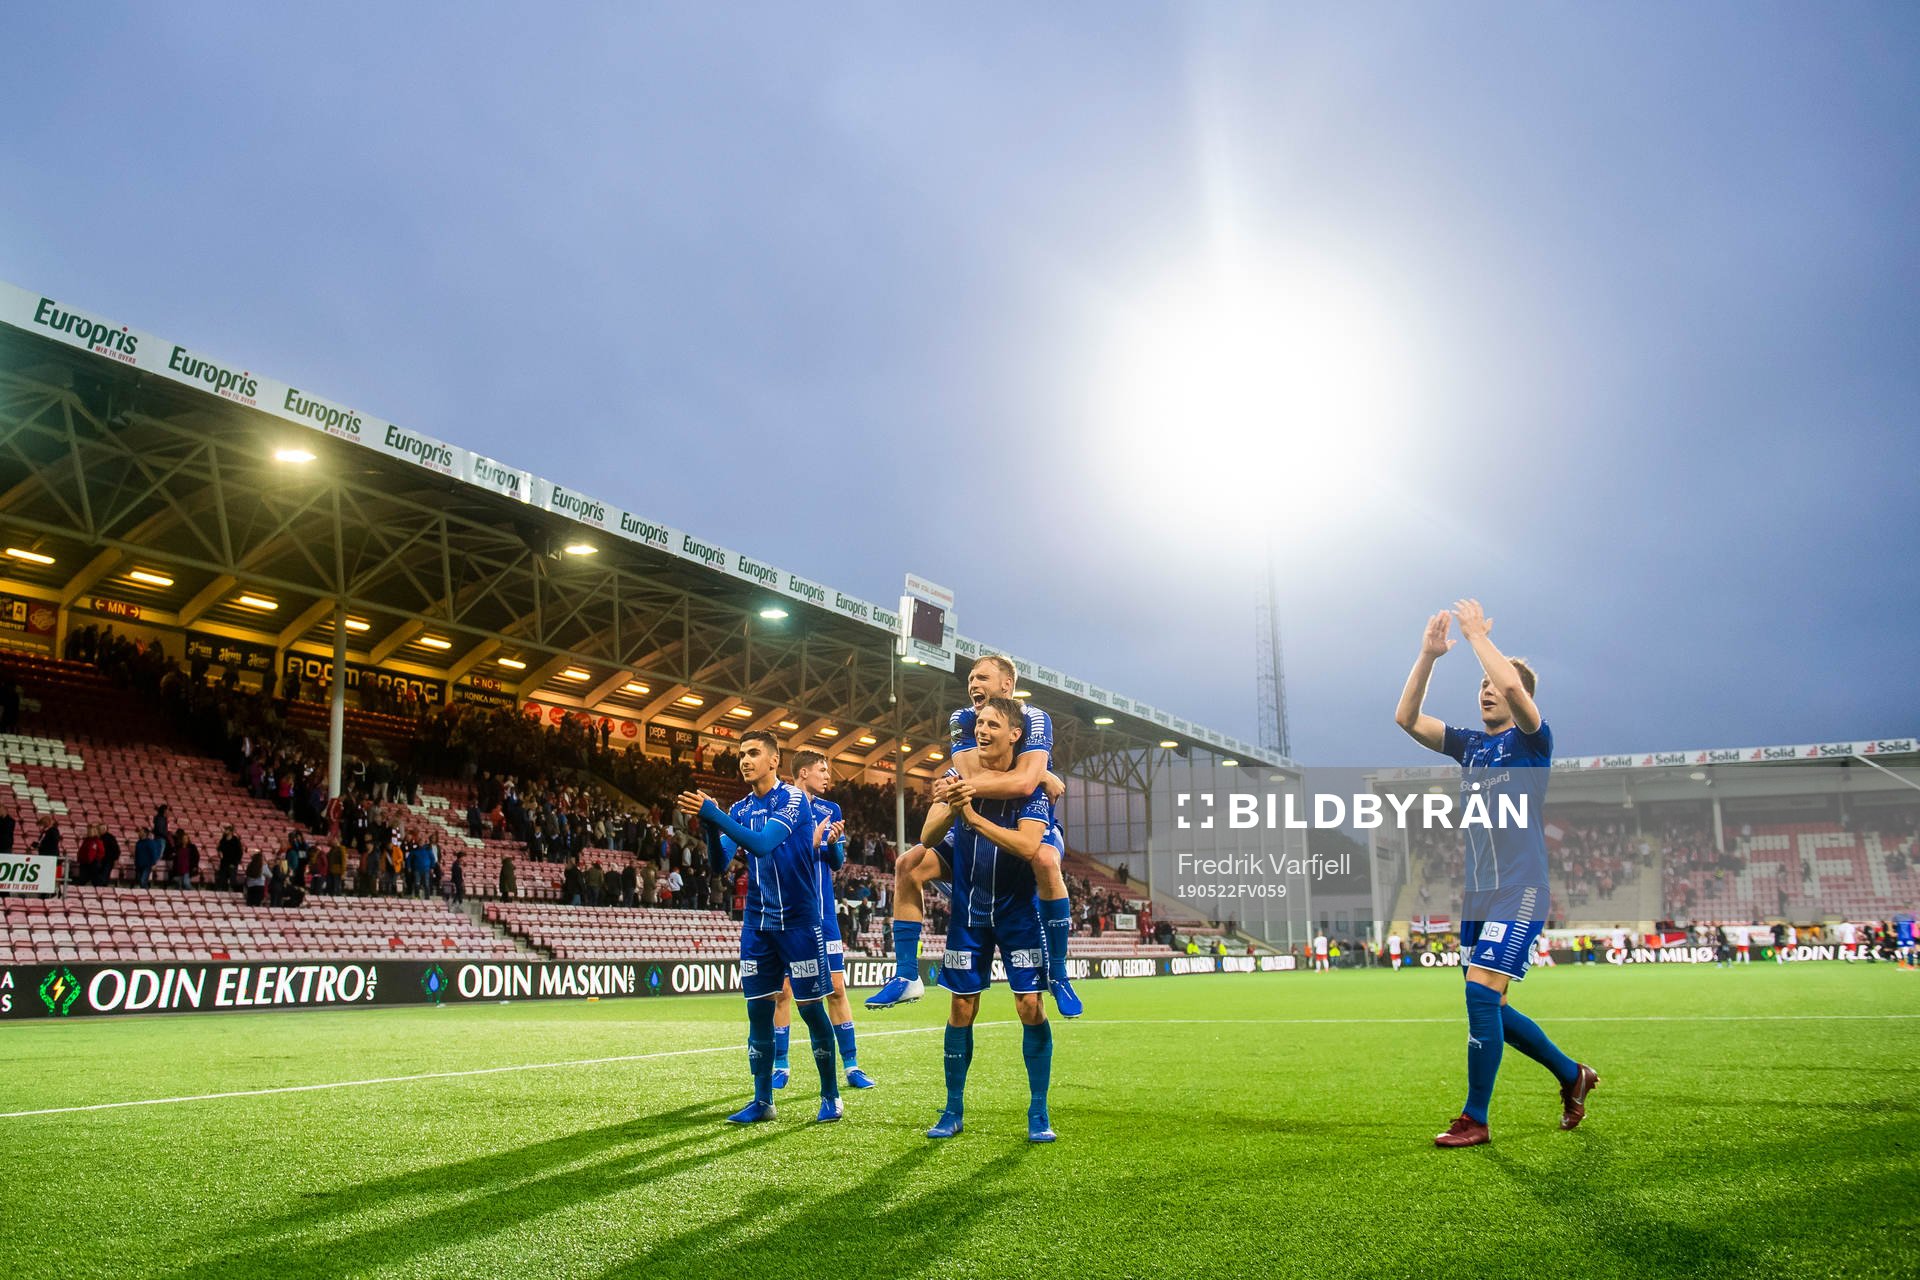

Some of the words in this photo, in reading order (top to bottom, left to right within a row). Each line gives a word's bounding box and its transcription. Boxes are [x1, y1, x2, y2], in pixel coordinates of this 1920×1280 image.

[34, 297, 138, 355] Europris
[168, 345, 258, 398] Europris
[284, 388, 362, 435] Europris
[384, 424, 453, 467] Europris
[552, 486, 605, 521] Europris
[621, 511, 669, 545] Europris
[683, 535, 726, 566] Europris
[738, 556, 778, 584] Europris
[789, 575, 825, 602] Europris
[107, 601, 127, 616] MN
[836, 592, 868, 618] Europris
[1655, 752, 1686, 764] Solid
[1709, 749, 1740, 761] Solid
[1764, 747, 1796, 760] Solid
[1820, 744, 1853, 756] Solid
[1878, 740, 1911, 752] Solid
[1602, 756, 1633, 767] Solid
[829, 942, 843, 953] DN
[946, 950, 968, 968] DNB
[1013, 950, 1040, 967] DNB
[457, 964, 532, 998] ODIN
[539, 964, 627, 996] MASKIN
[671, 963, 725, 993] ODIN
[792, 960, 816, 978] DNB
[853, 962, 897, 985] ELEKT
[88, 967, 207, 1011] ODIN
[215, 965, 366, 1006] ELEKTRO
